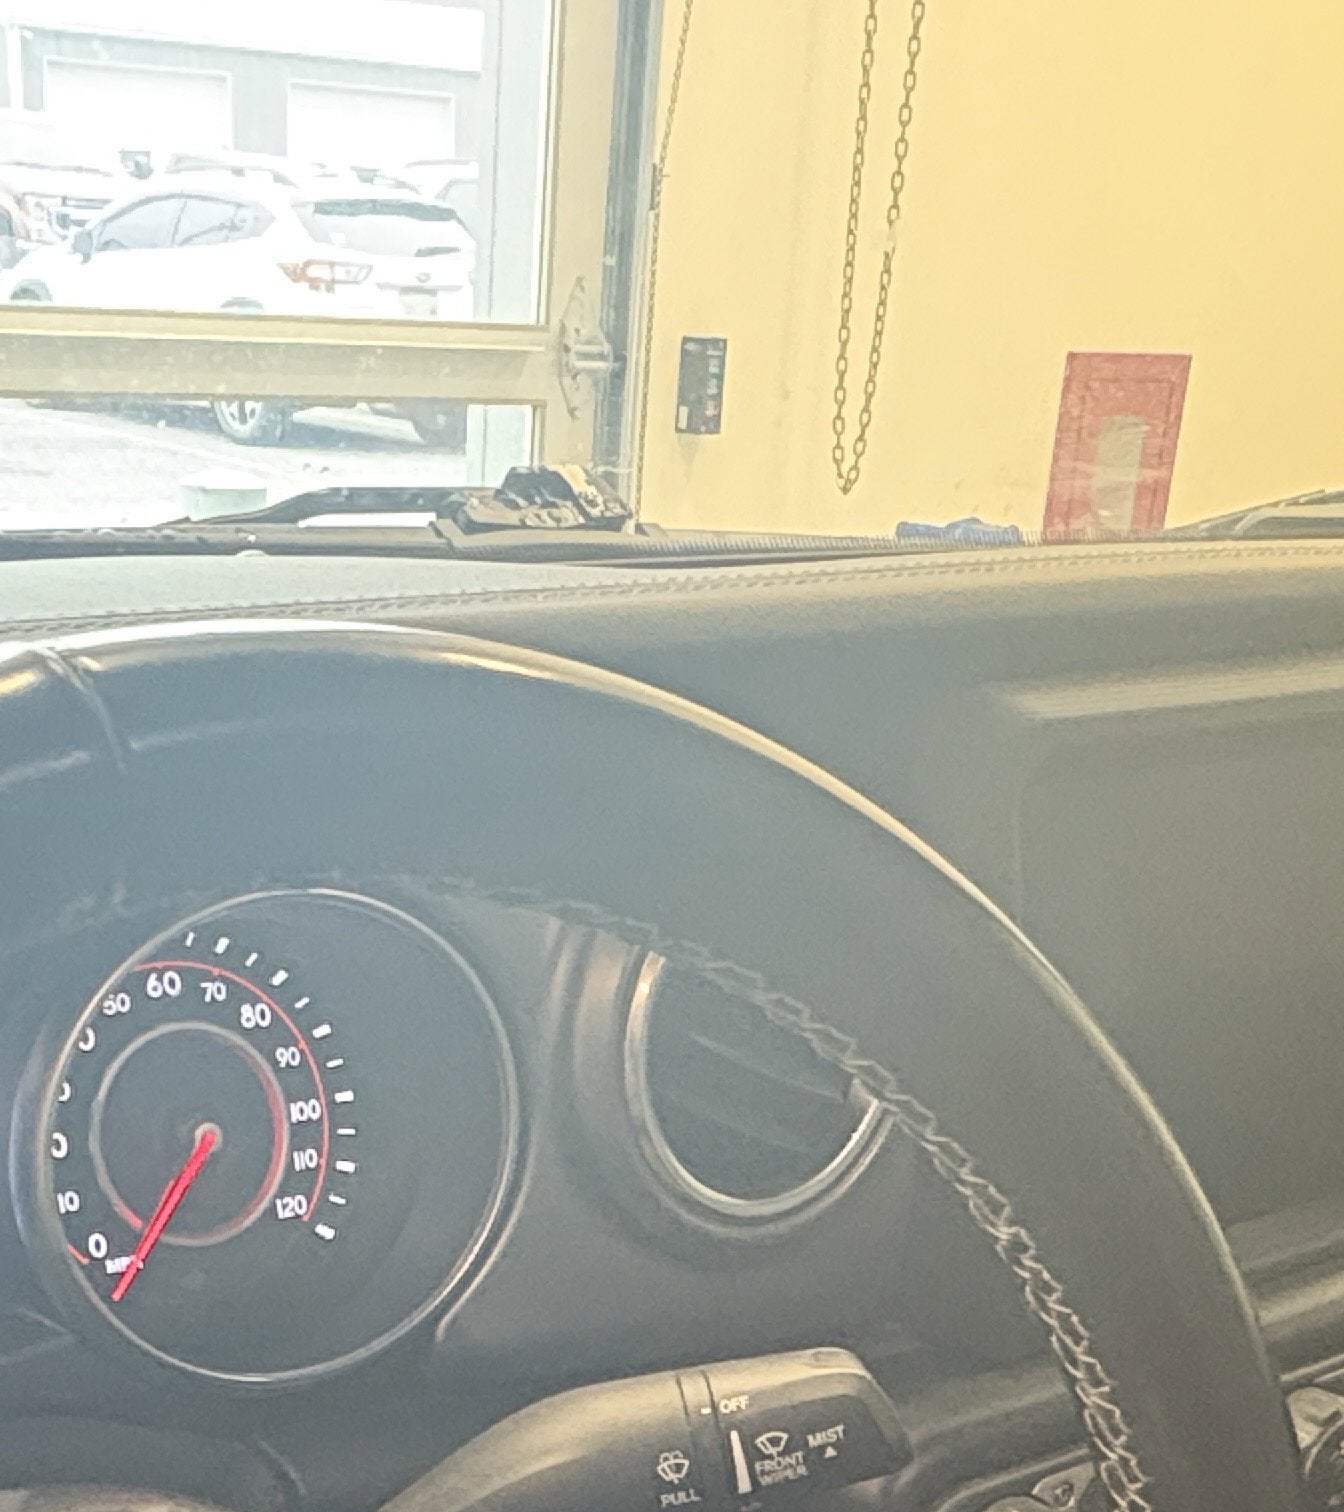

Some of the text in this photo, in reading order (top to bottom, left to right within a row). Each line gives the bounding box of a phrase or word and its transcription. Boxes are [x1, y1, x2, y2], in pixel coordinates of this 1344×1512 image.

[147, 971, 181, 998] 60
[200, 982, 227, 1002] 70
[240, 1002, 272, 1029] 80
[275, 1045, 301, 1068] 90
[290, 1099, 322, 1122] 100
[292, 1150, 318, 1171] 110
[56, 1191, 80, 1214] 10
[275, 1196, 308, 1219] 120
[88, 1232, 108, 1259] 0
[719, 1395, 750, 1415] OFF
[806, 1425, 845, 1449] MIST
[754, 1451, 804, 1475] FRONT
[660, 1489, 702, 1508] PULL
